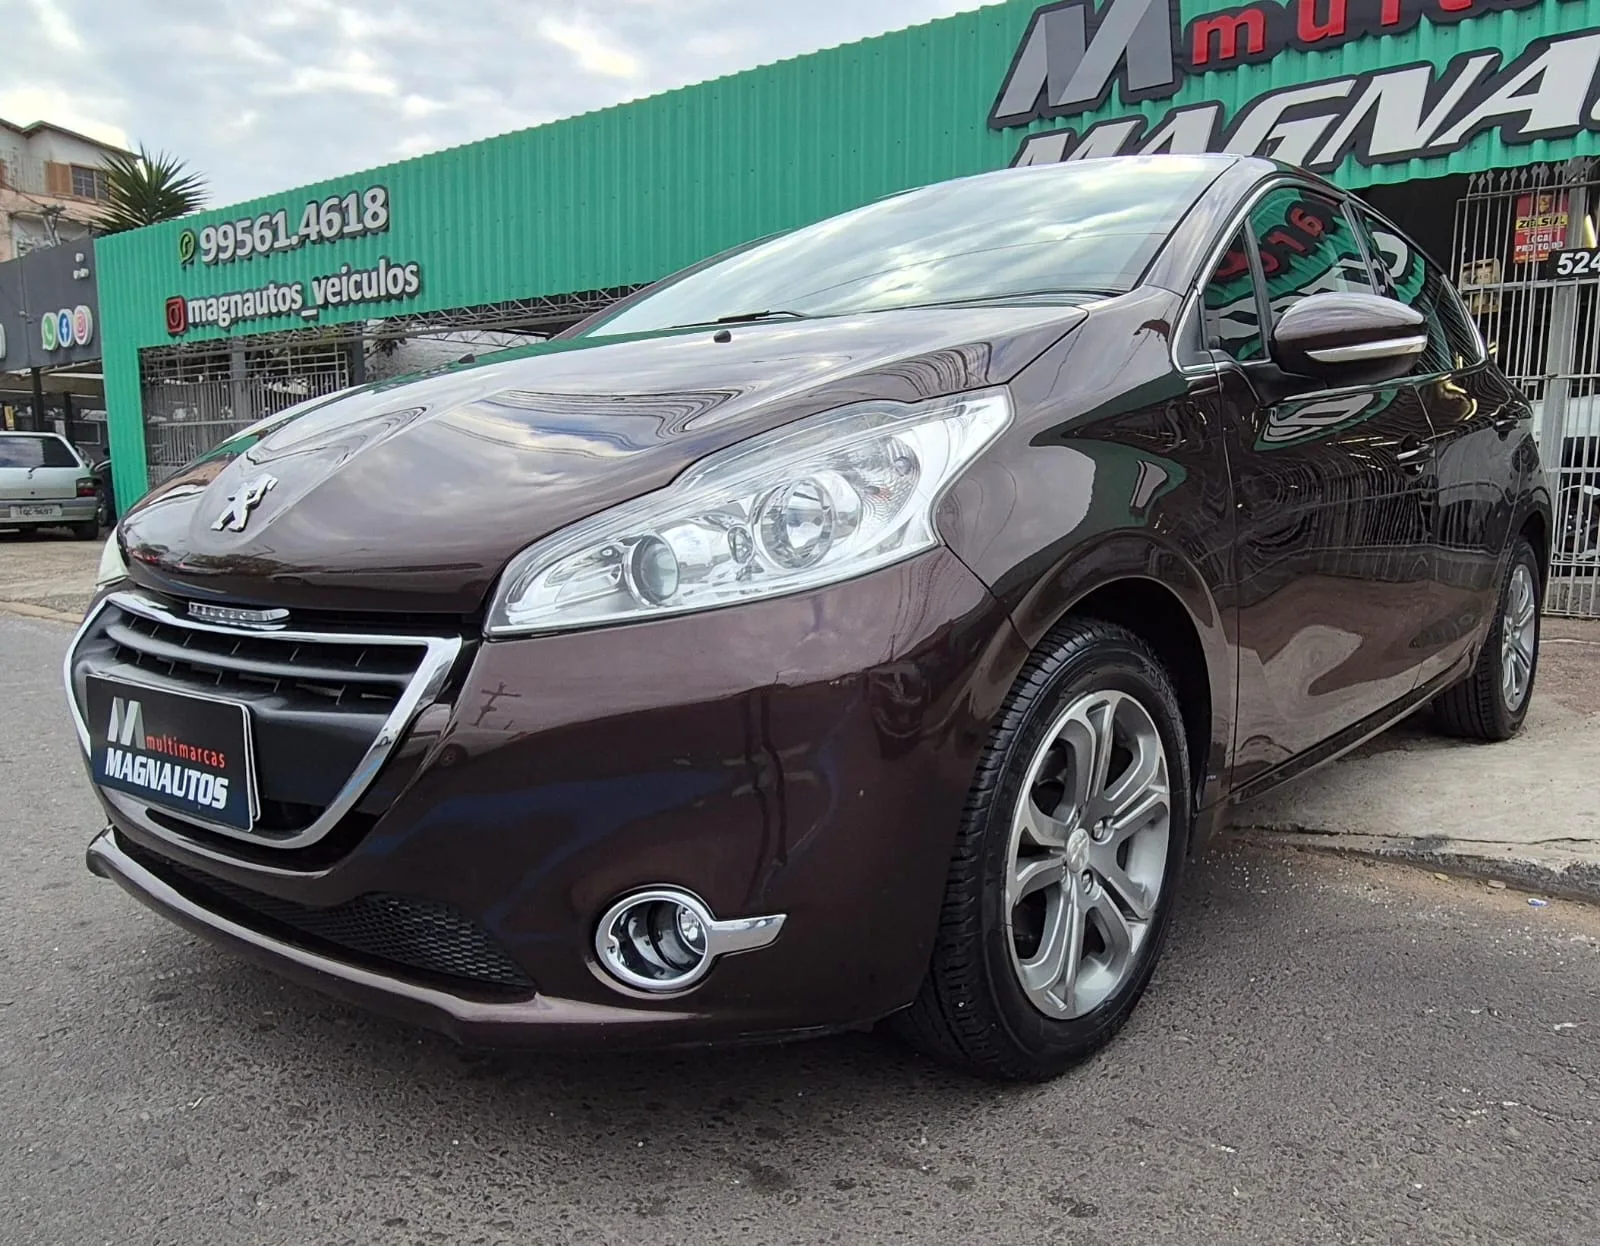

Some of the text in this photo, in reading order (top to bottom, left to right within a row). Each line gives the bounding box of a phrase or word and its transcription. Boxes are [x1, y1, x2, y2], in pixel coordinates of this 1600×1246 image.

[1192, 0, 1473, 65] mu
[1014, 33, 1600, 168] MAGNA
[200, 187, 388, 264] 99561.4618
[188, 258, 419, 327] magnautos_veiculos
[105, 747, 229, 810] MAGNAUTOS
[146, 734, 225, 769] multimarcas
